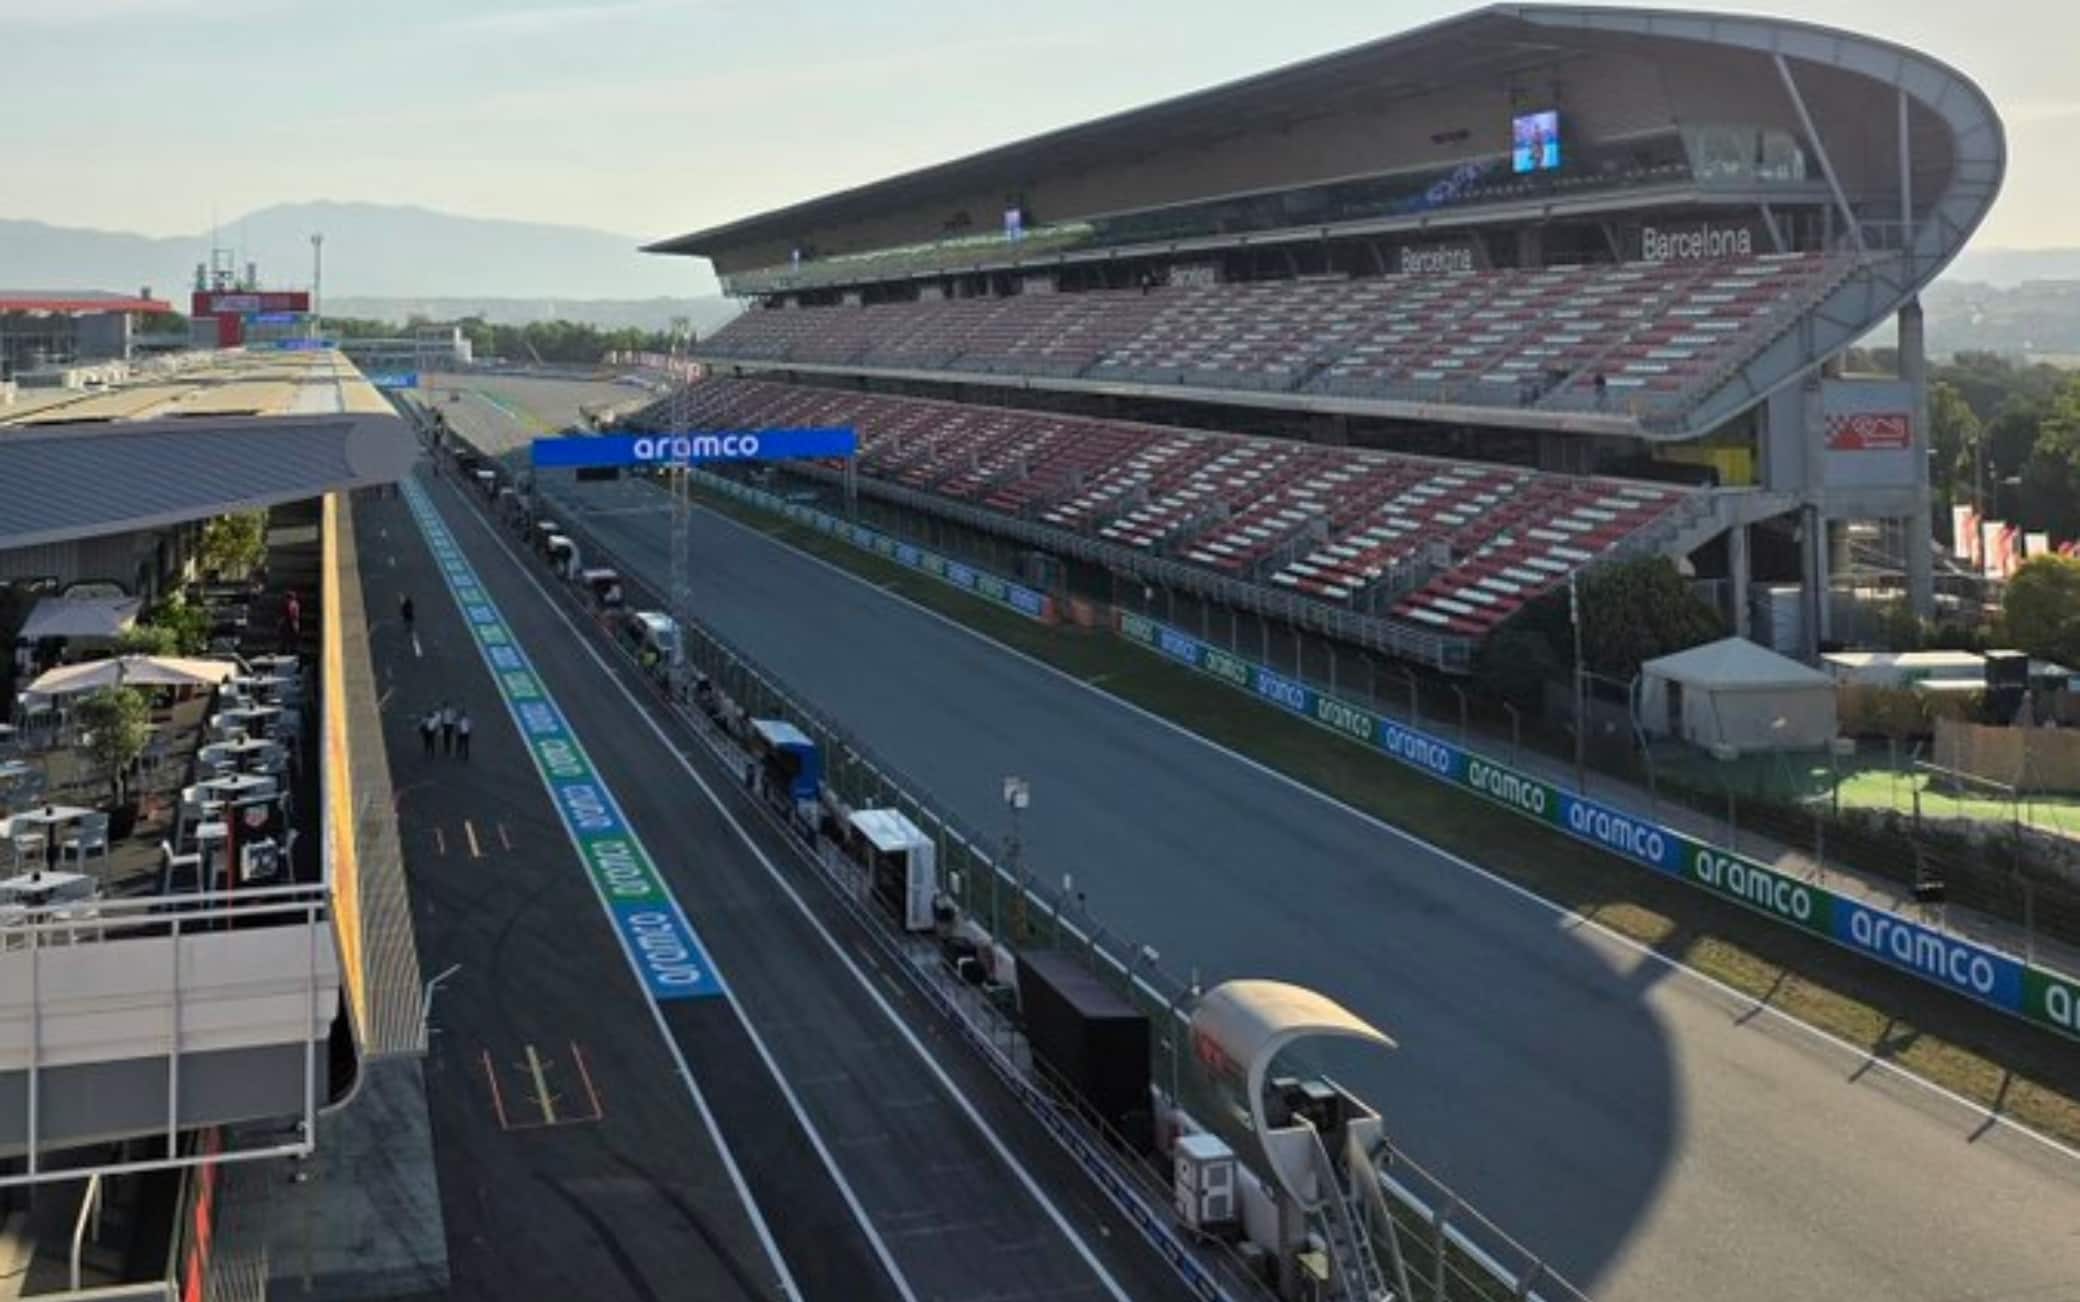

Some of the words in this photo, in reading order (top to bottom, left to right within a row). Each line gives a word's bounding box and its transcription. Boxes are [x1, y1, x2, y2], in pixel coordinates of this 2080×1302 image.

[1642, 221, 1752, 260] Barcelona
[633, 434, 759, 460] aramco
[1317, 697, 1372, 739] aramco
[1384, 727, 1450, 773] aramco
[1468, 760, 1545, 814] aramco
[1569, 802, 1665, 862] aramco
[1695, 849, 1811, 920] aramco
[1850, 910, 1994, 993] aramco
